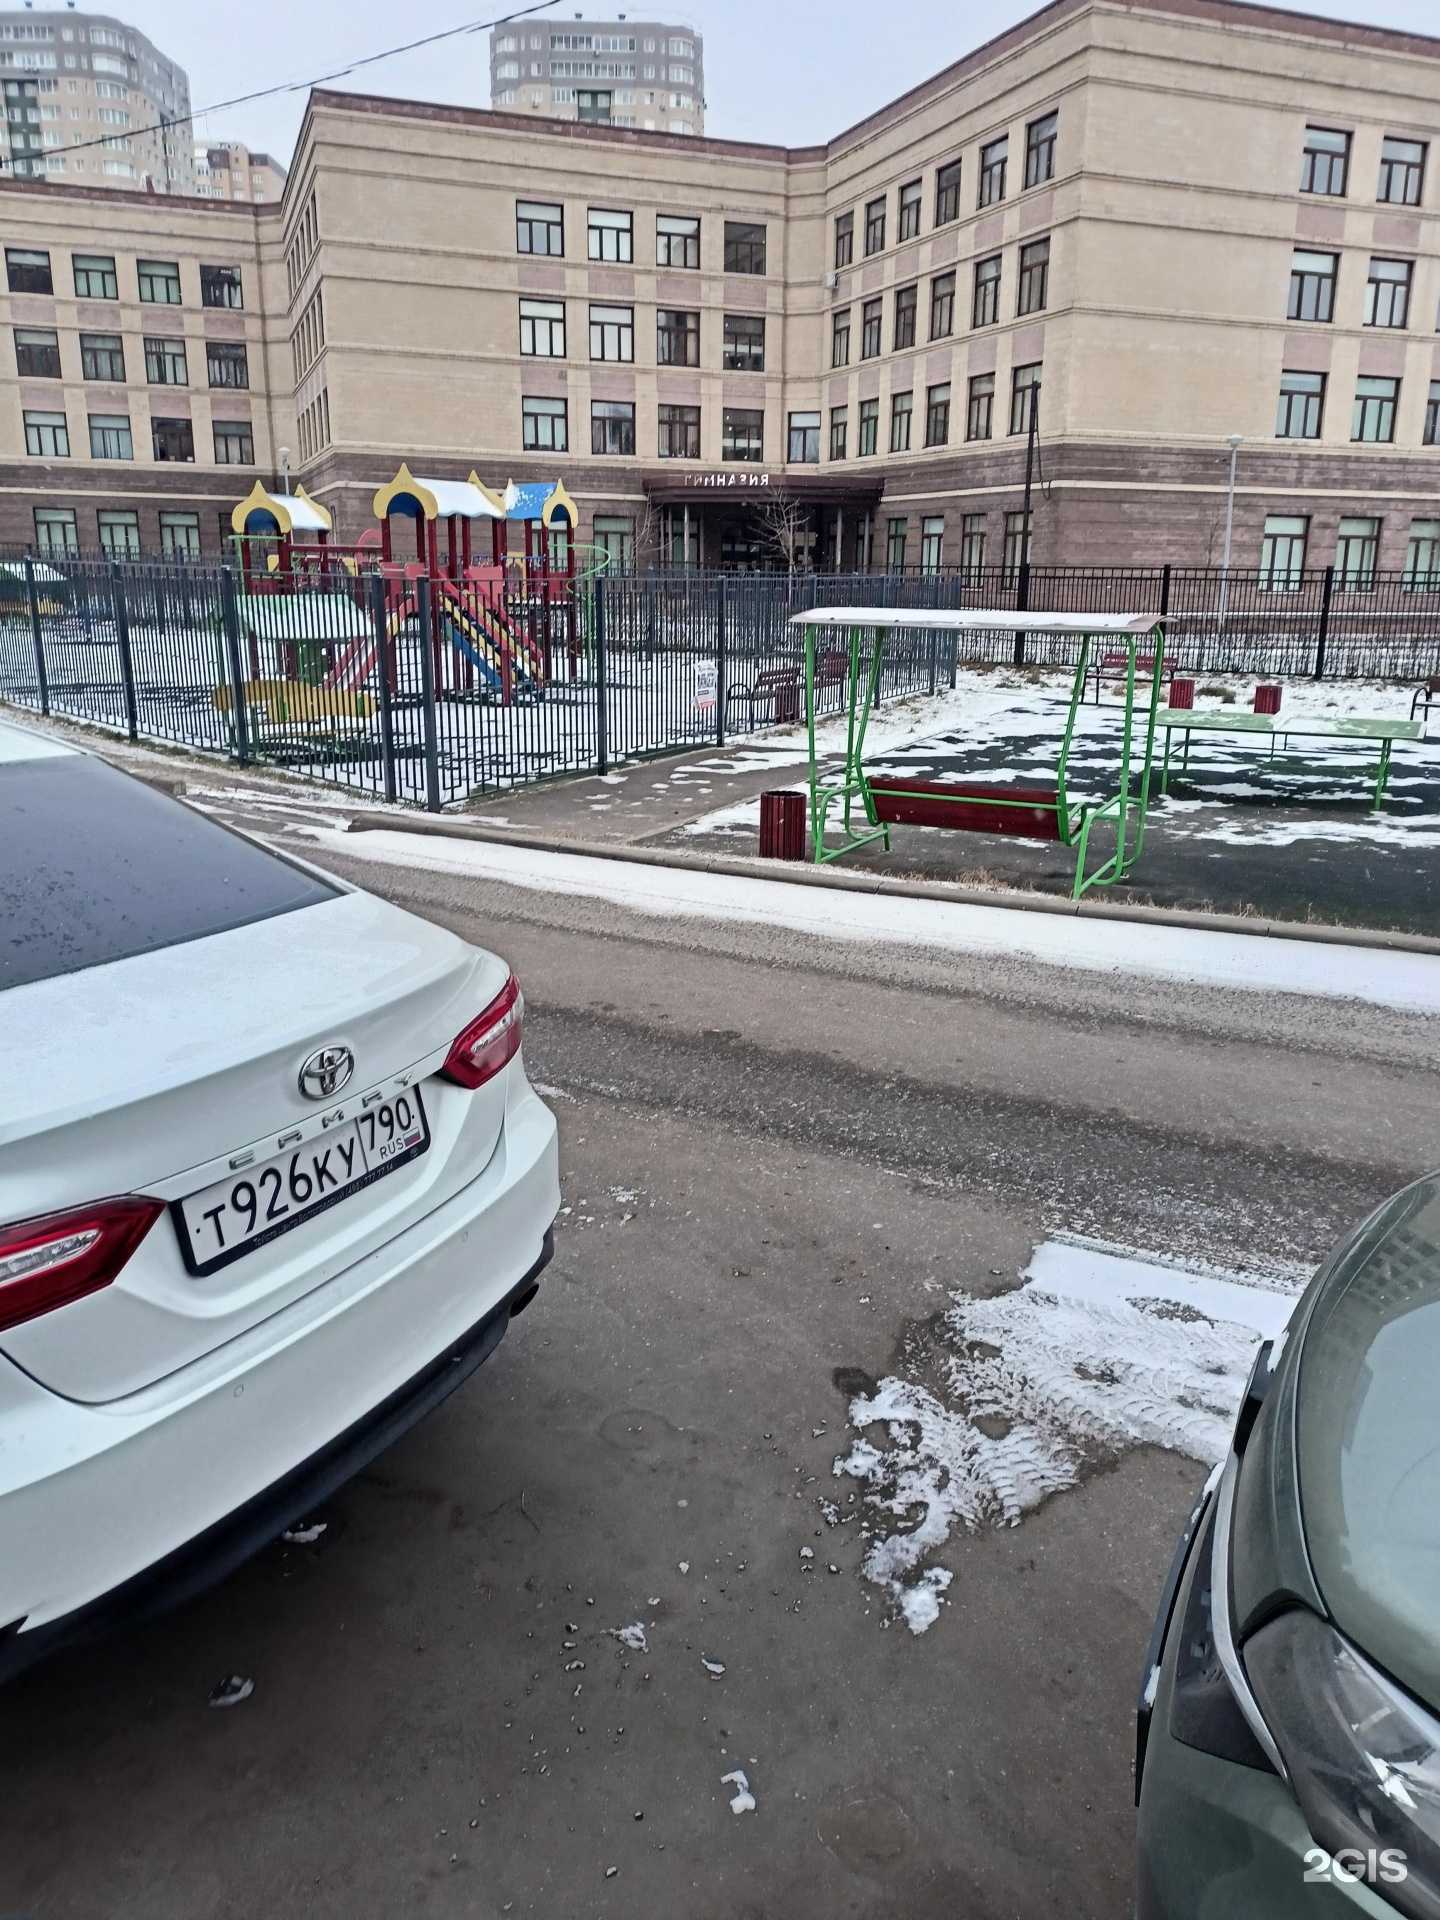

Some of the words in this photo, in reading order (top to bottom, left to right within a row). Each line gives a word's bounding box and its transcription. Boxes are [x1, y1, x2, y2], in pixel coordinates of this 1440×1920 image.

[684, 473, 769, 487] ГИМНАЗИЯ
[379, 1138, 404, 1160] RUS
[203, 1135, 355, 1248] Т926КУ
[359, 1097, 412, 1151] 790
